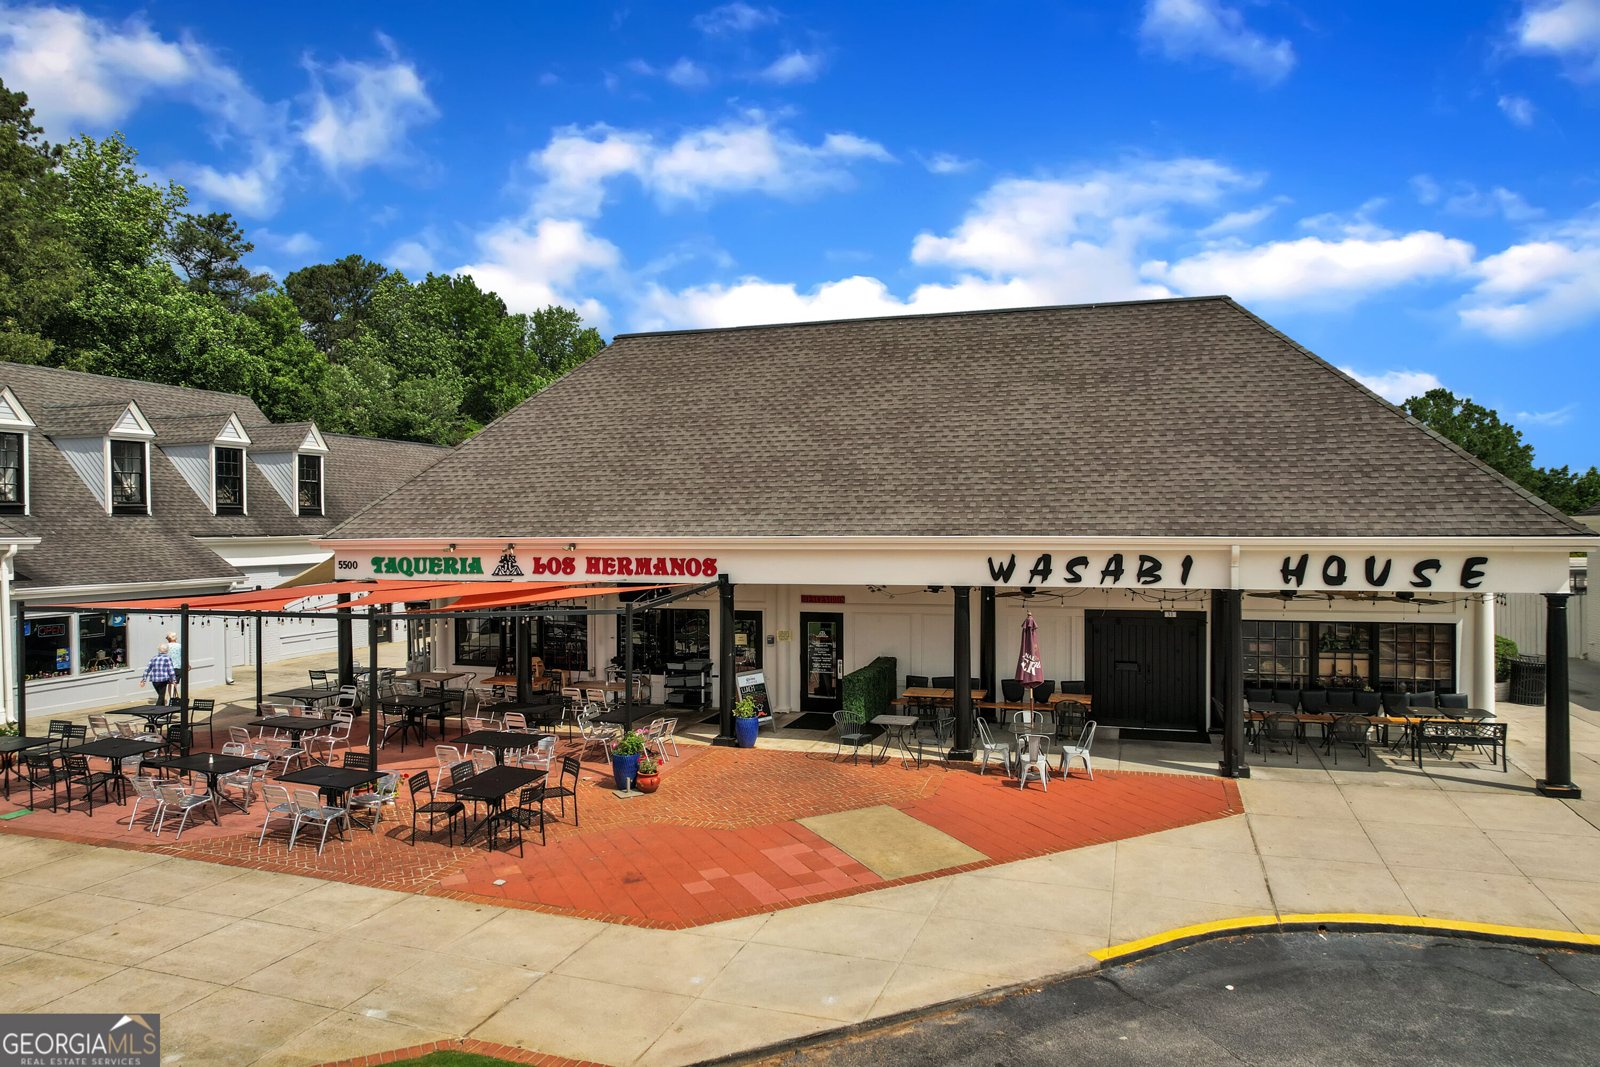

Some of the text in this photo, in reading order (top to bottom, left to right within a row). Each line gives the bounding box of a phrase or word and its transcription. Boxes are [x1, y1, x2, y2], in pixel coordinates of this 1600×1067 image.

[338, 560, 358, 570] 5500
[370, 556, 718, 577] TAQUERIA LOS HERMANOS
[987, 553, 1489, 588] WASABI HOUSE
